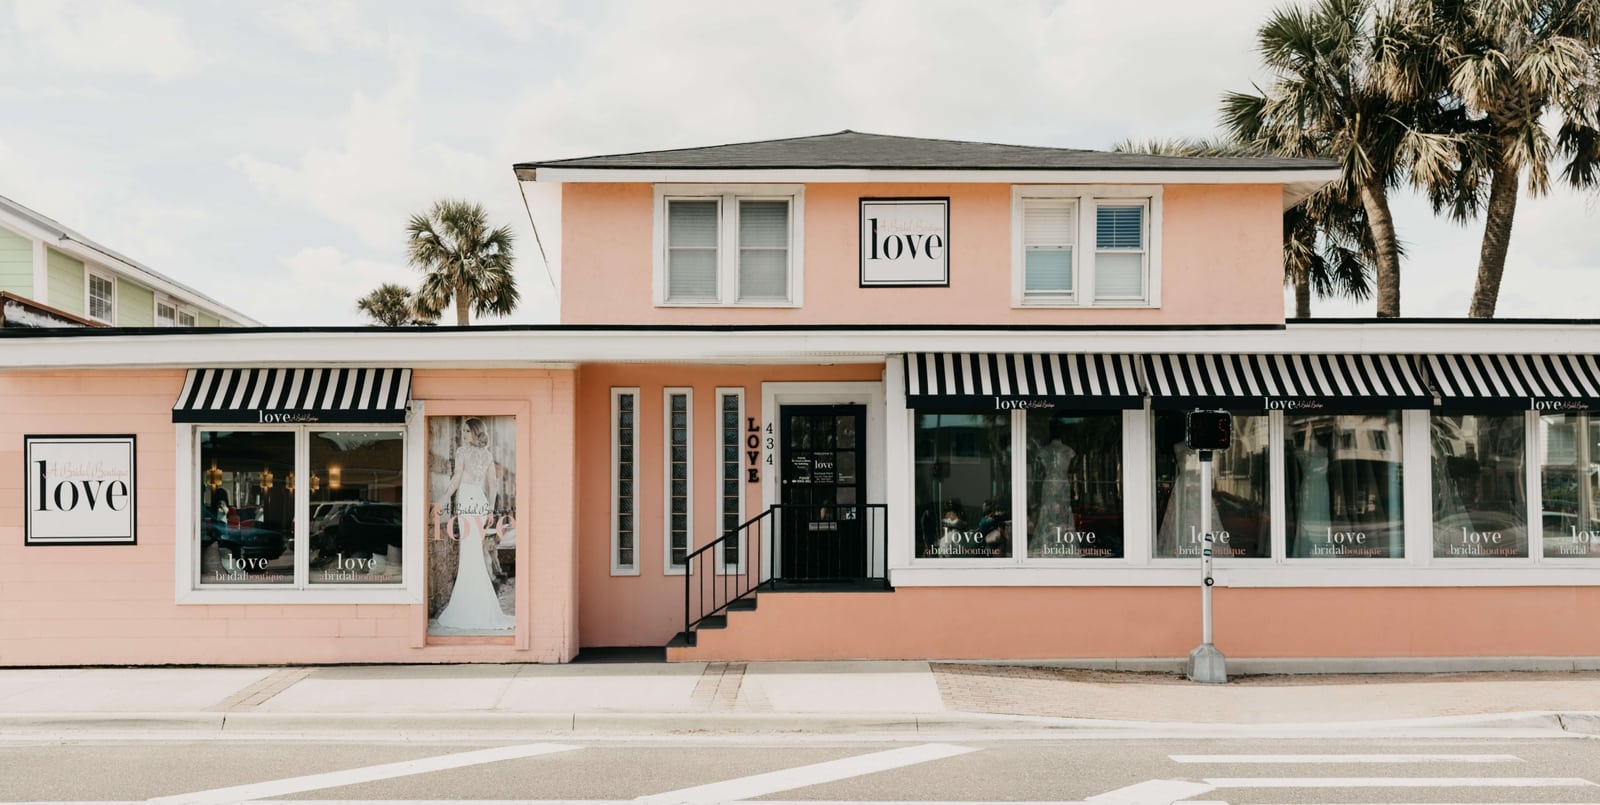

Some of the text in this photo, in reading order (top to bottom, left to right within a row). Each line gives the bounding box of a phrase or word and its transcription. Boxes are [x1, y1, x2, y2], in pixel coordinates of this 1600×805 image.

[866, 217, 944, 261] love
[995, 396, 1027, 410] love
[1263, 397, 1296, 410] love
[1530, 397, 1562, 410] love
[258, 409, 291, 423] love
[747, 417, 760, 483] LOVE
[766, 422, 774, 465] 434
[814, 459, 833, 469] love
[33, 459, 129, 512] love
[428, 502, 516, 542] love
[943, 526, 983, 544] love
[1055, 526, 1096, 544] love
[1326, 527, 1366, 544] love
[1461, 526, 1502, 544] love
[1569, 525, 1600, 544] lov
[227, 553, 268, 570] love
[336, 552, 377, 570] love
